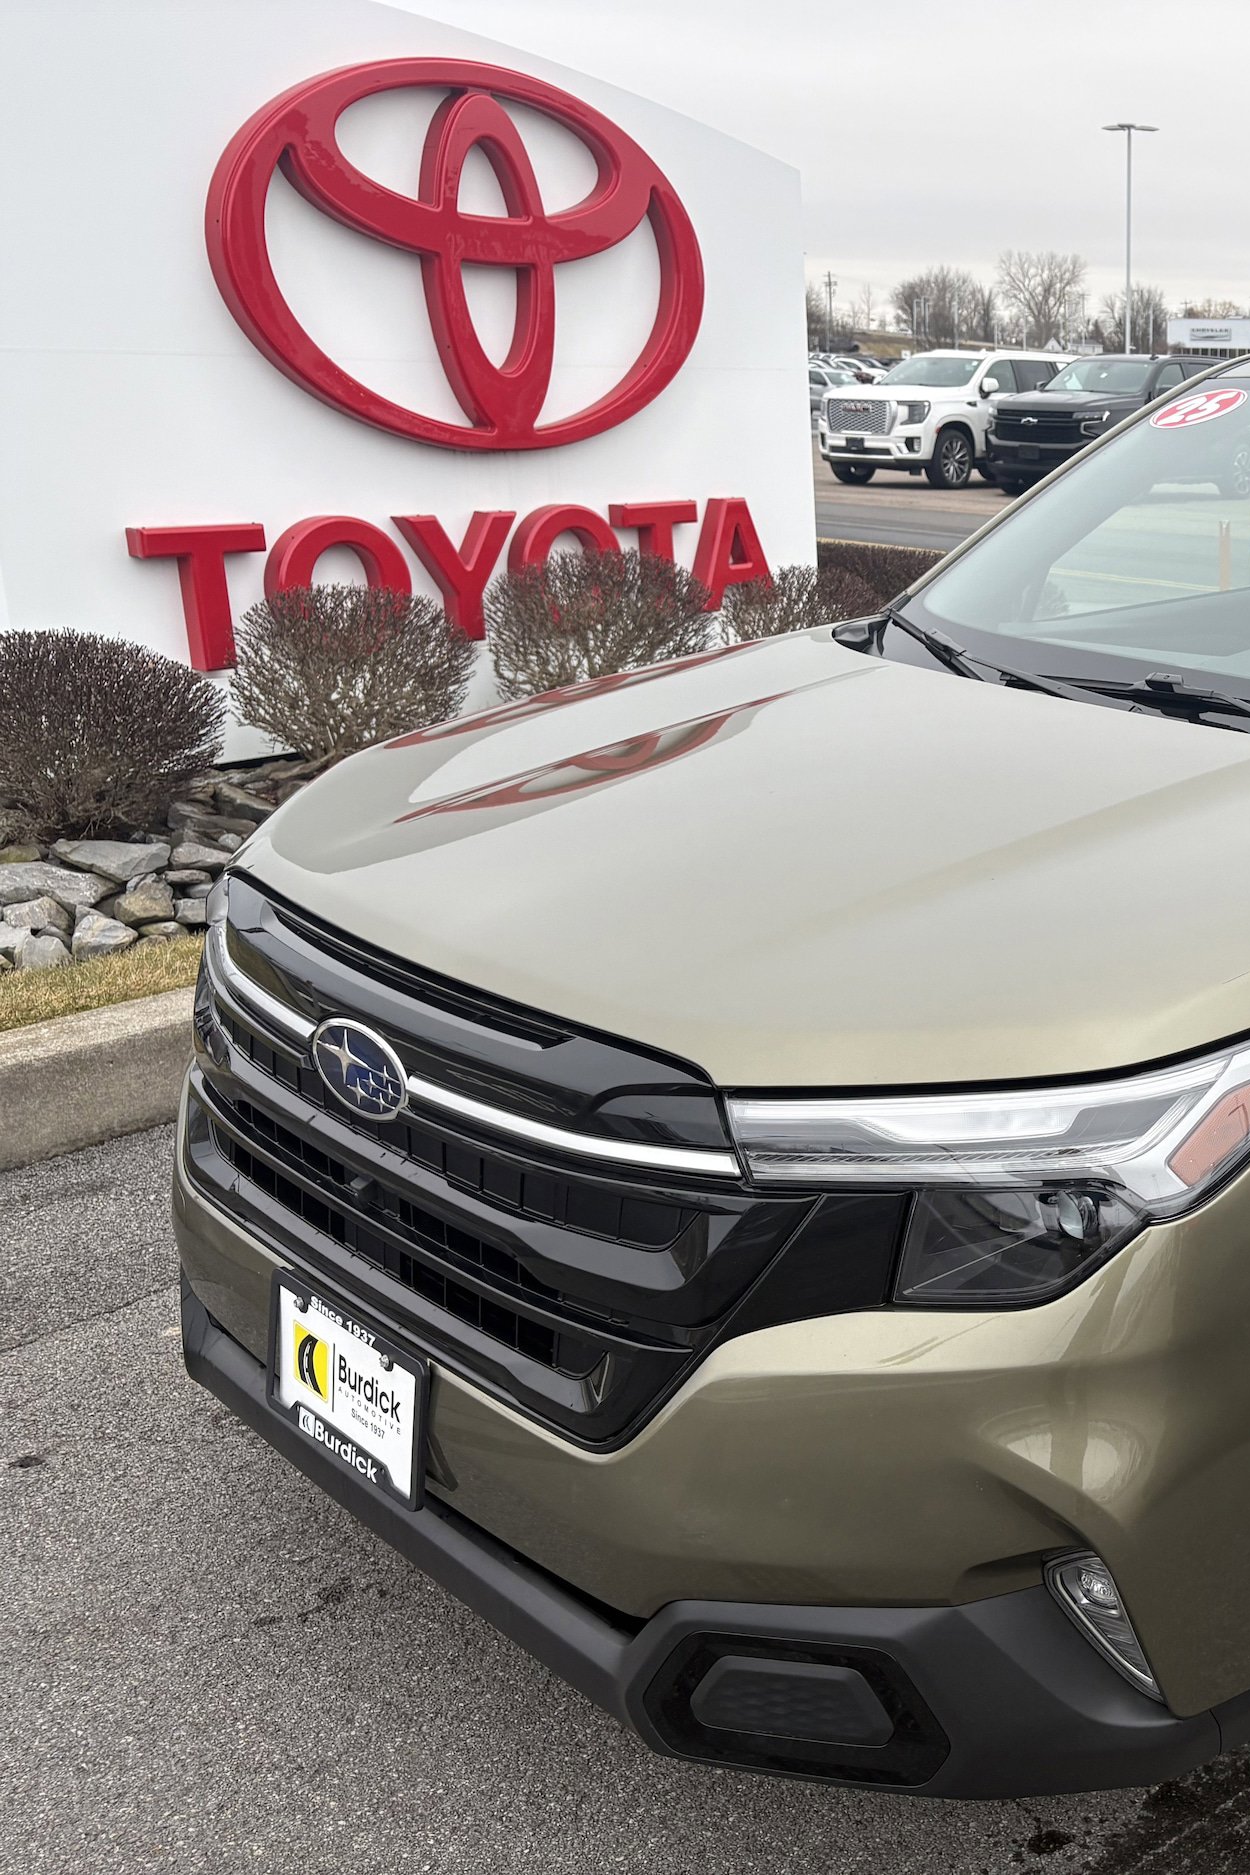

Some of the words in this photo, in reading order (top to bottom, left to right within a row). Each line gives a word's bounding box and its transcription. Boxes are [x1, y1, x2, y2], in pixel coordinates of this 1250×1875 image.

[1155, 391, 1241, 426] 25
[310, 1296, 343, 1326] Since
[346, 1320, 376, 1347] 1937
[338, 1386, 401, 1435] AUTOMOTIVE
[339, 1354, 400, 1423] Burdick
[351, 1408, 369, 1428] Since
[370, 1422, 386, 1439] 1937
[315, 1420, 377, 1483] Burdick
